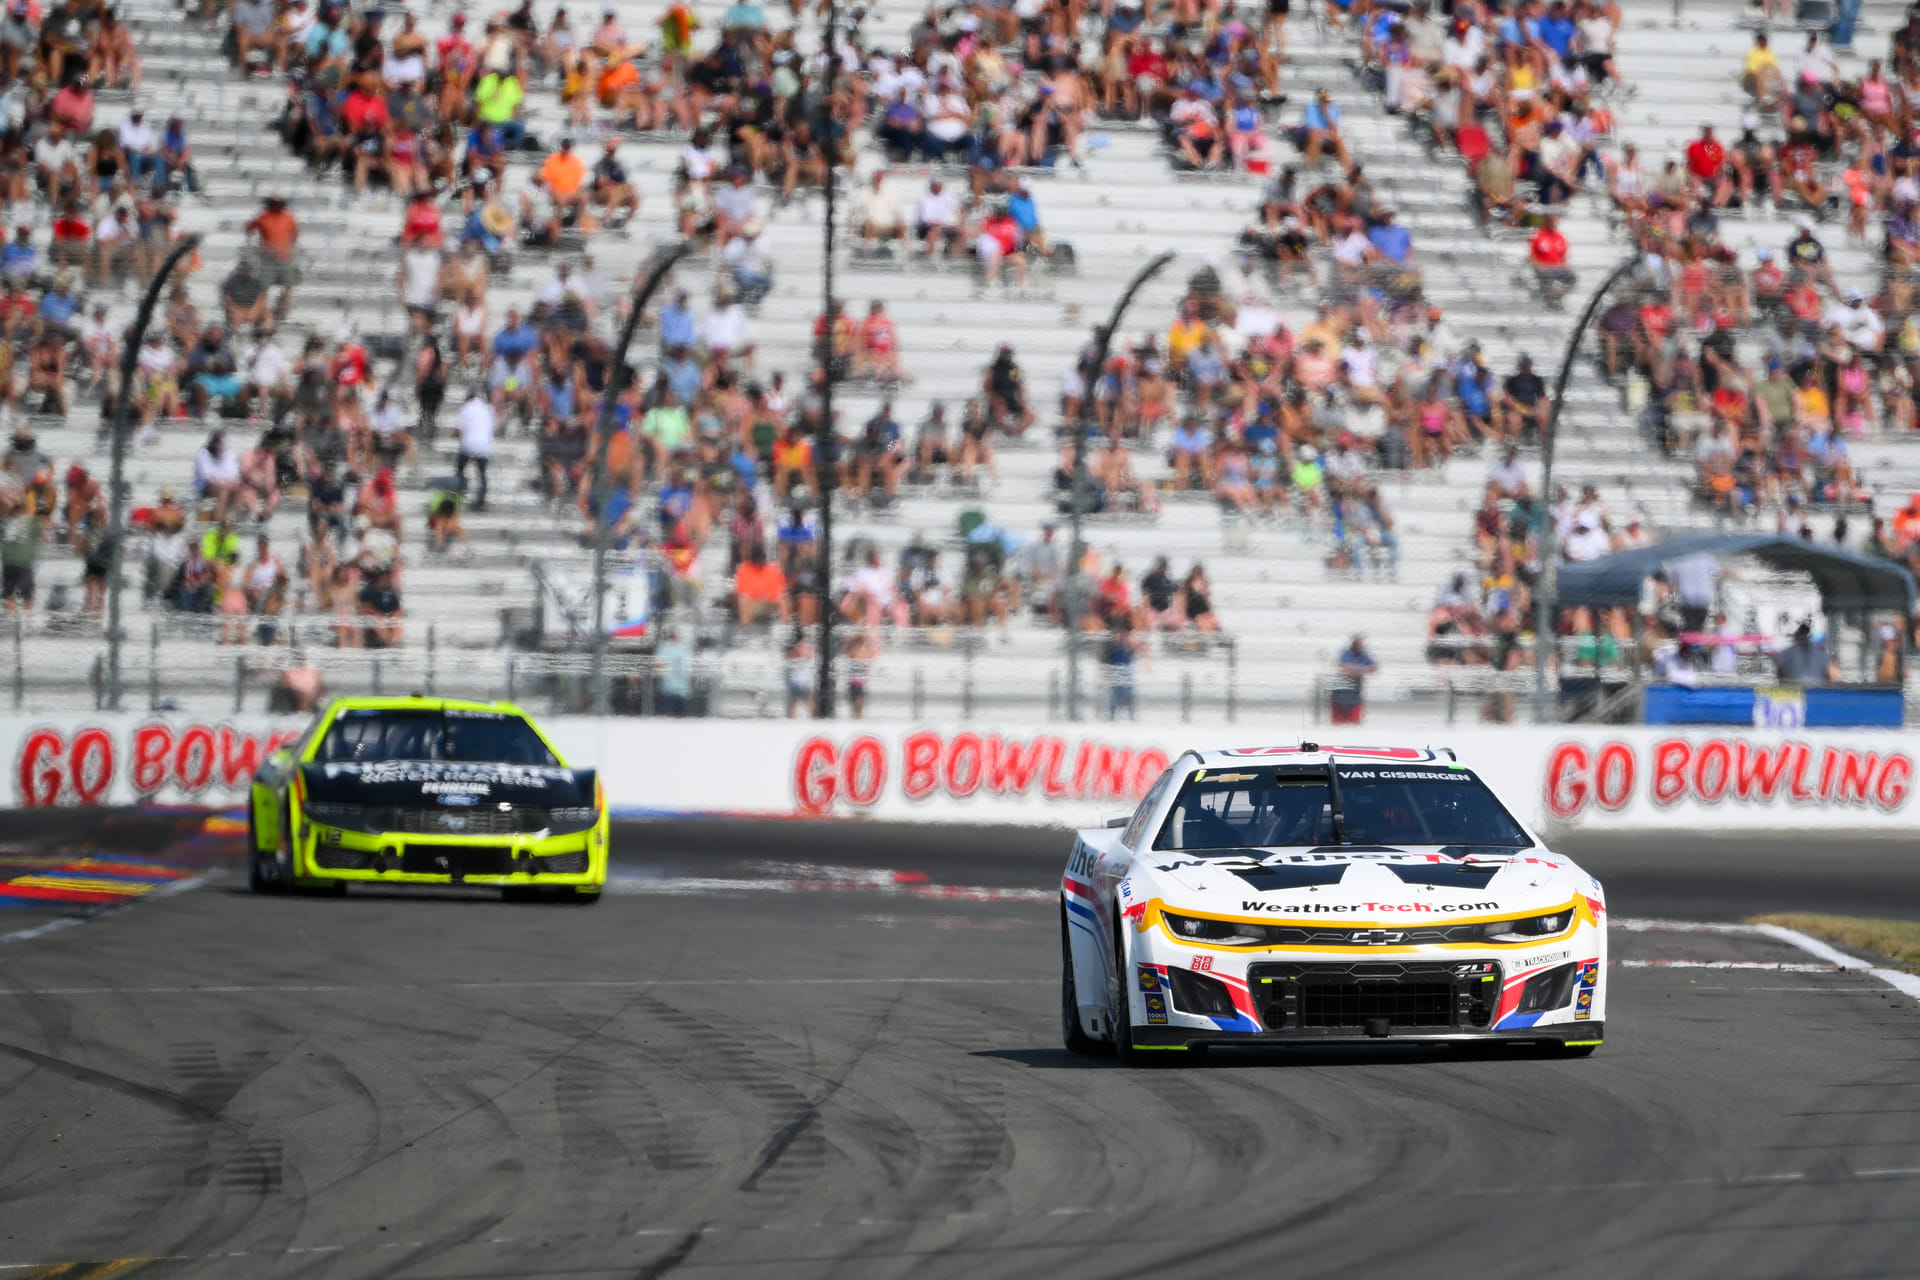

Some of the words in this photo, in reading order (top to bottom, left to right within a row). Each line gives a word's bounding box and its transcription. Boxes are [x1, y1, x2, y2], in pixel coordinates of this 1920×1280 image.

[19, 727, 115, 806] GO
[132, 723, 300, 791] BOW
[796, 735, 886, 811] GO
[1338, 771, 1376, 779] VAN
[1379, 771, 1472, 781] GISBERGEN
[1547, 740, 1636, 817] GO
[1652, 738, 1914, 810] BOWLING
[1242, 900, 1499, 914] WeatherTech.com
[1190, 954, 1214, 971] 88
[1454, 963, 1492, 974] ZL1
